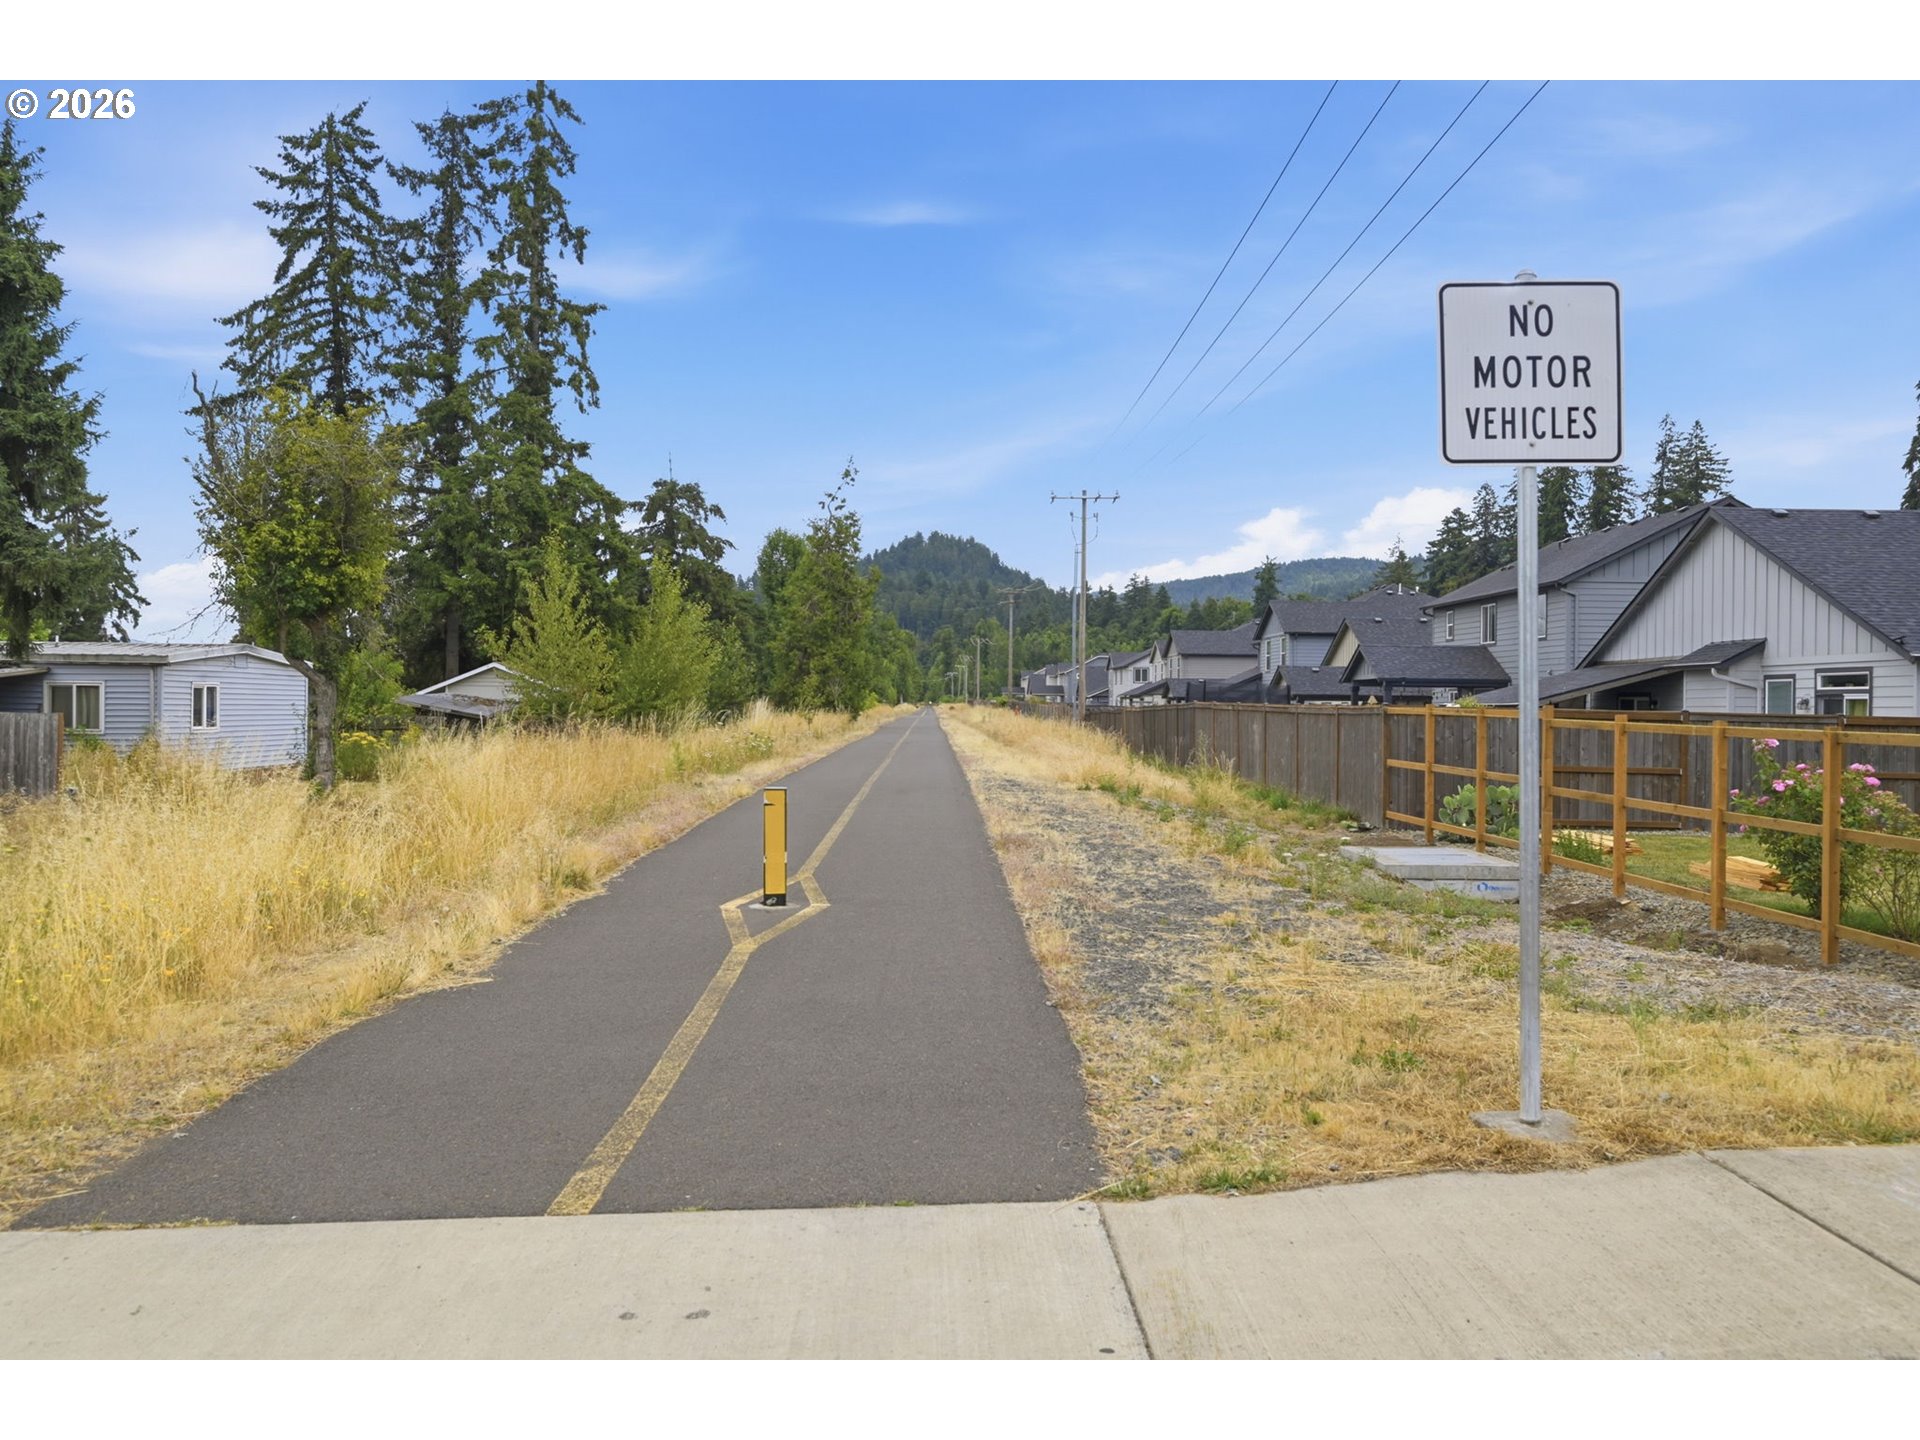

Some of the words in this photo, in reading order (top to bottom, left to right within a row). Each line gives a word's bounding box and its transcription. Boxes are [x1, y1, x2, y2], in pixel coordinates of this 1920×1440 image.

[1509, 304, 1554, 337] NO
[1474, 355, 1592, 389] MOTOR
[1465, 406, 1598, 440] VEHICLES
